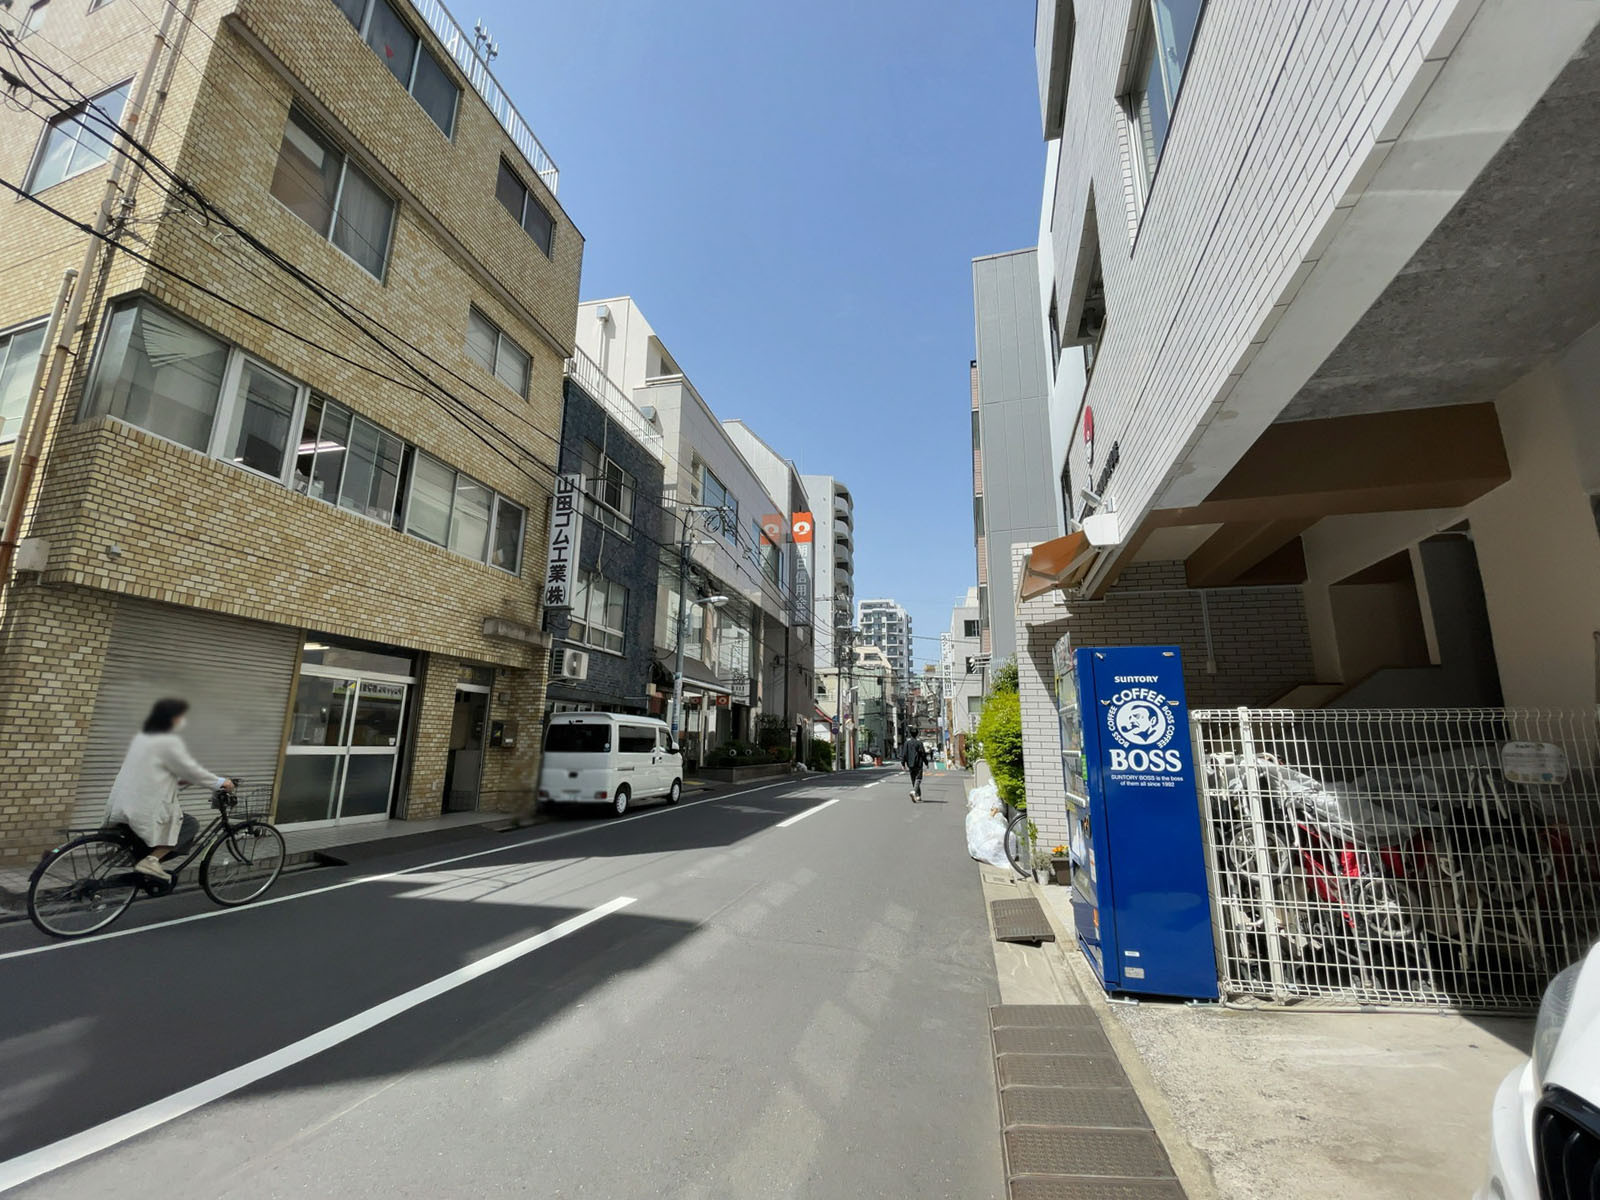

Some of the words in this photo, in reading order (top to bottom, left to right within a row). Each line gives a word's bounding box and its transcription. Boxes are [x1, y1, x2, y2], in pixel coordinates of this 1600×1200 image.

[1114, 675, 1159, 683] SUNTORY
[1112, 688, 1166, 706] COFFEE
[1109, 749, 1182, 772] BOSS
